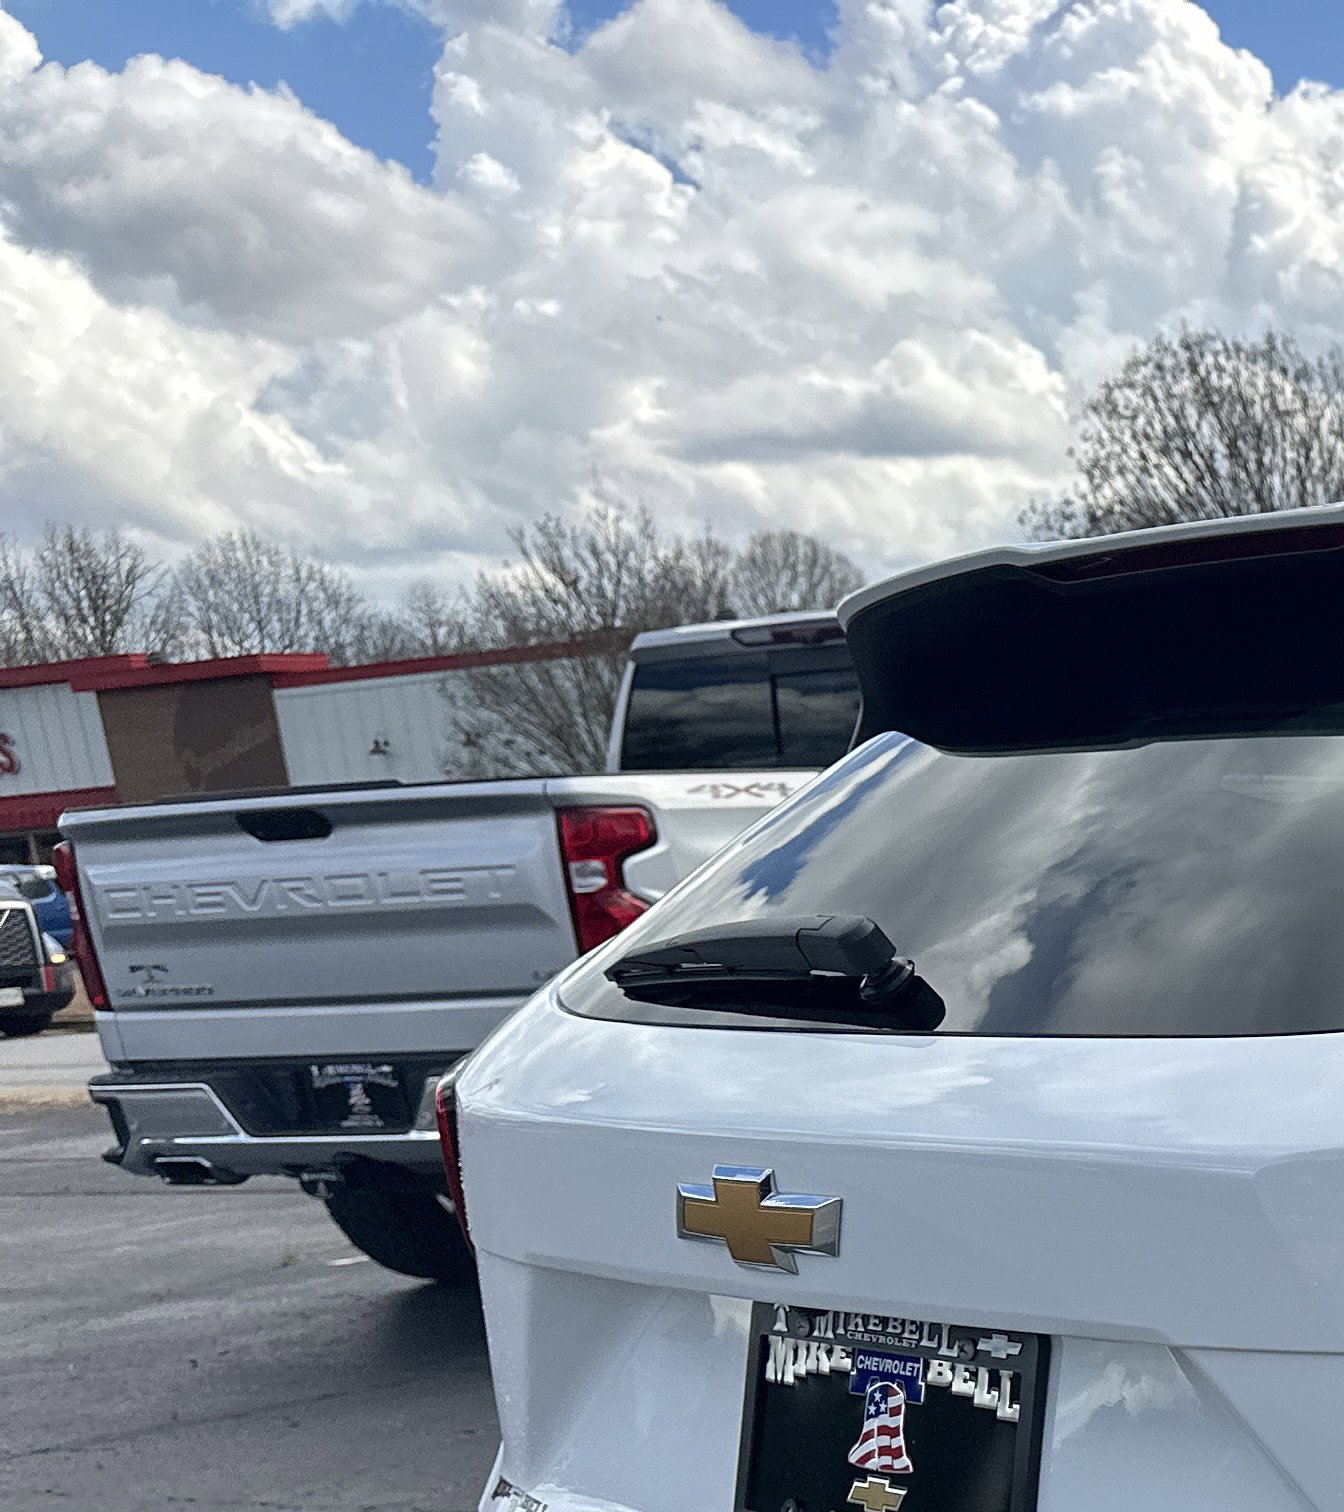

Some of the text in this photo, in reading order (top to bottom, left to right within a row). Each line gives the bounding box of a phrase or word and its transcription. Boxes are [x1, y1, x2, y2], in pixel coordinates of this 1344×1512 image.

[104, 864, 517, 919] CHEVROLET
[847, 1331, 918, 1349] CHEVROLET
[765, 1335, 1020, 1422] MIKE BELL
[857, 1354, 921, 1377] CHEVROLET
